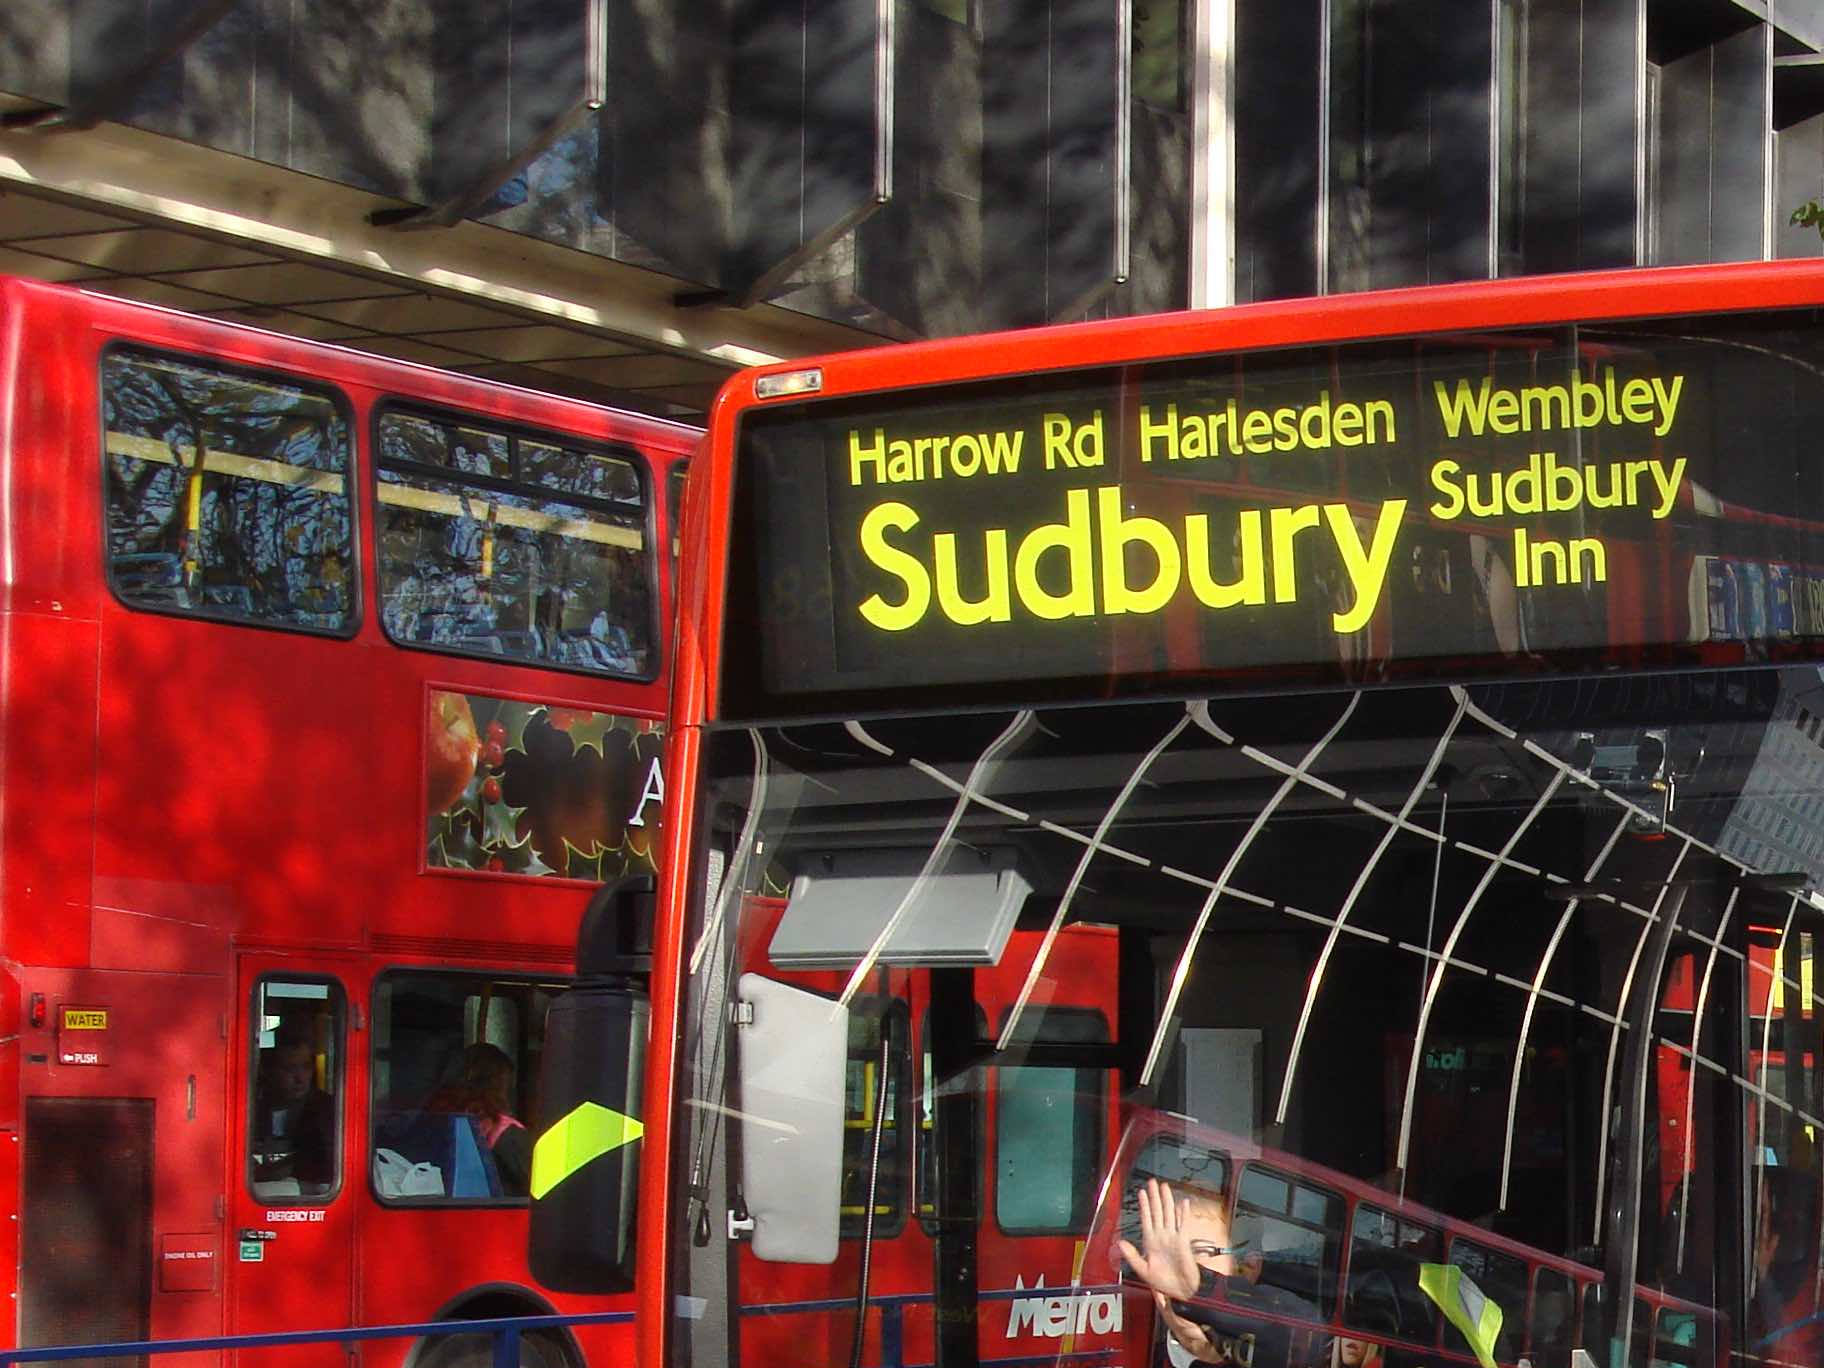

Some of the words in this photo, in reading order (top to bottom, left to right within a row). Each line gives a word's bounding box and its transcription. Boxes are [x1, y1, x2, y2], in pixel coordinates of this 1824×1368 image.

[848, 427, 1023, 485] Harrow
[1044, 410, 1105, 468] Rd
[1140, 390, 1397, 462] Harlesden
[1434, 374, 1684, 439] Wembley
[1429, 456, 1689, 522] Sudbury
[857, 484, 1409, 635] Sudbury
[1514, 528, 1607, 588] Inn
[67, 1014, 105, 1027] WATER
[74, 1053, 98, 1064] PUSH
[266, 1210, 308, 1222] EMERGENCY
[309, 1210, 326, 1222] EXIT
